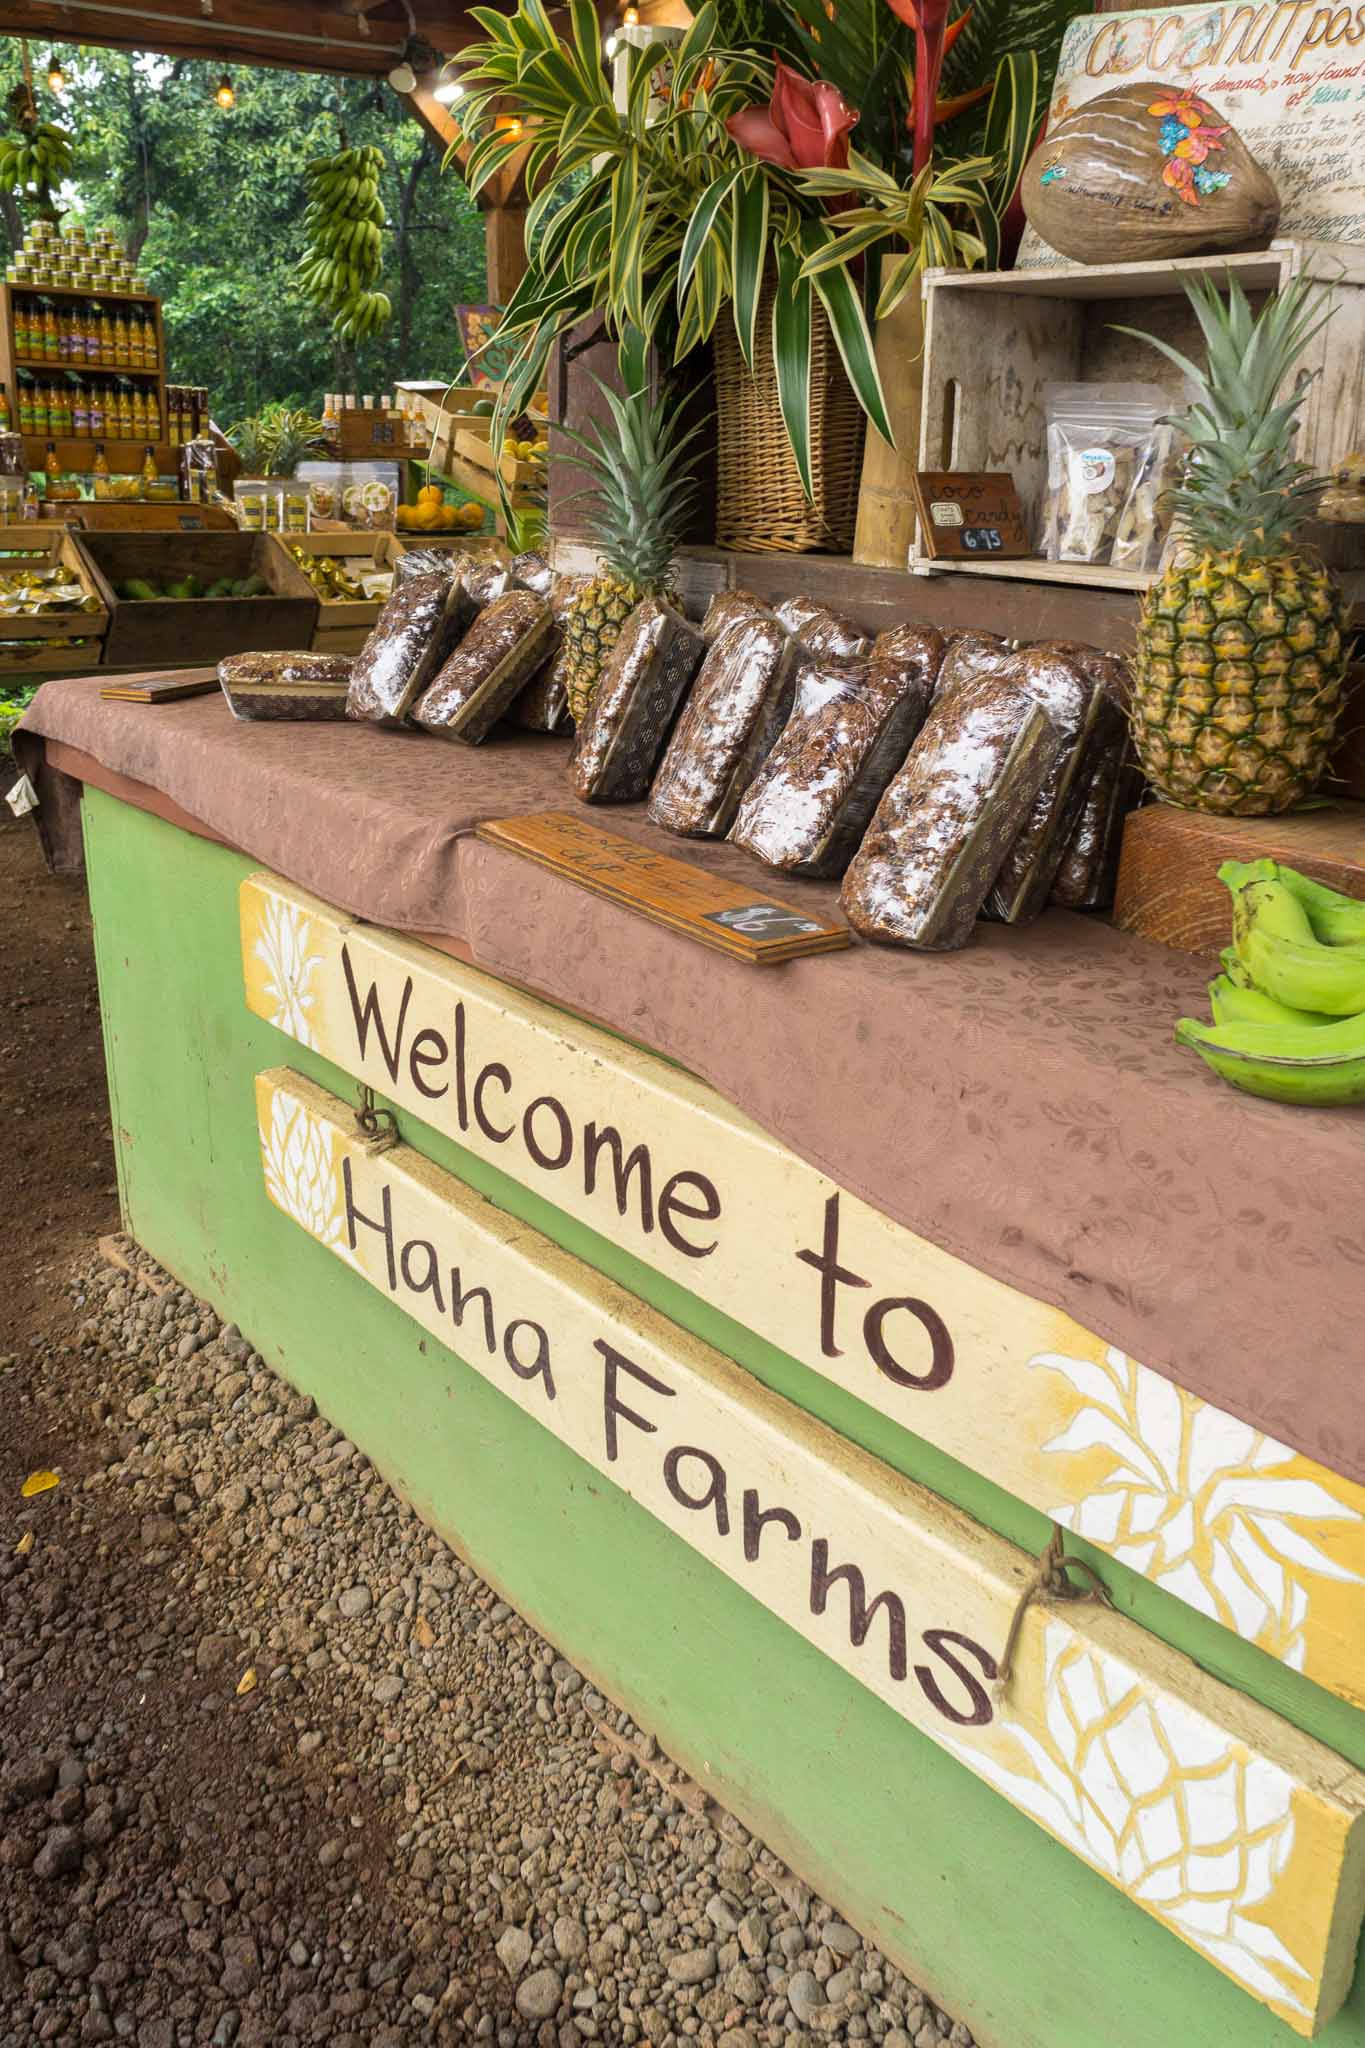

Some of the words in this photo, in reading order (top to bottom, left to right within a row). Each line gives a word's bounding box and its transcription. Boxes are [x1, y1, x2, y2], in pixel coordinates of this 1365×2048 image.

[341, 942, 722, 1258] Welcome
[795, 1190, 955, 1391] to
[341, 1156, 557, 1401] Hana
[593, 1338, 998, 1726] Farms
